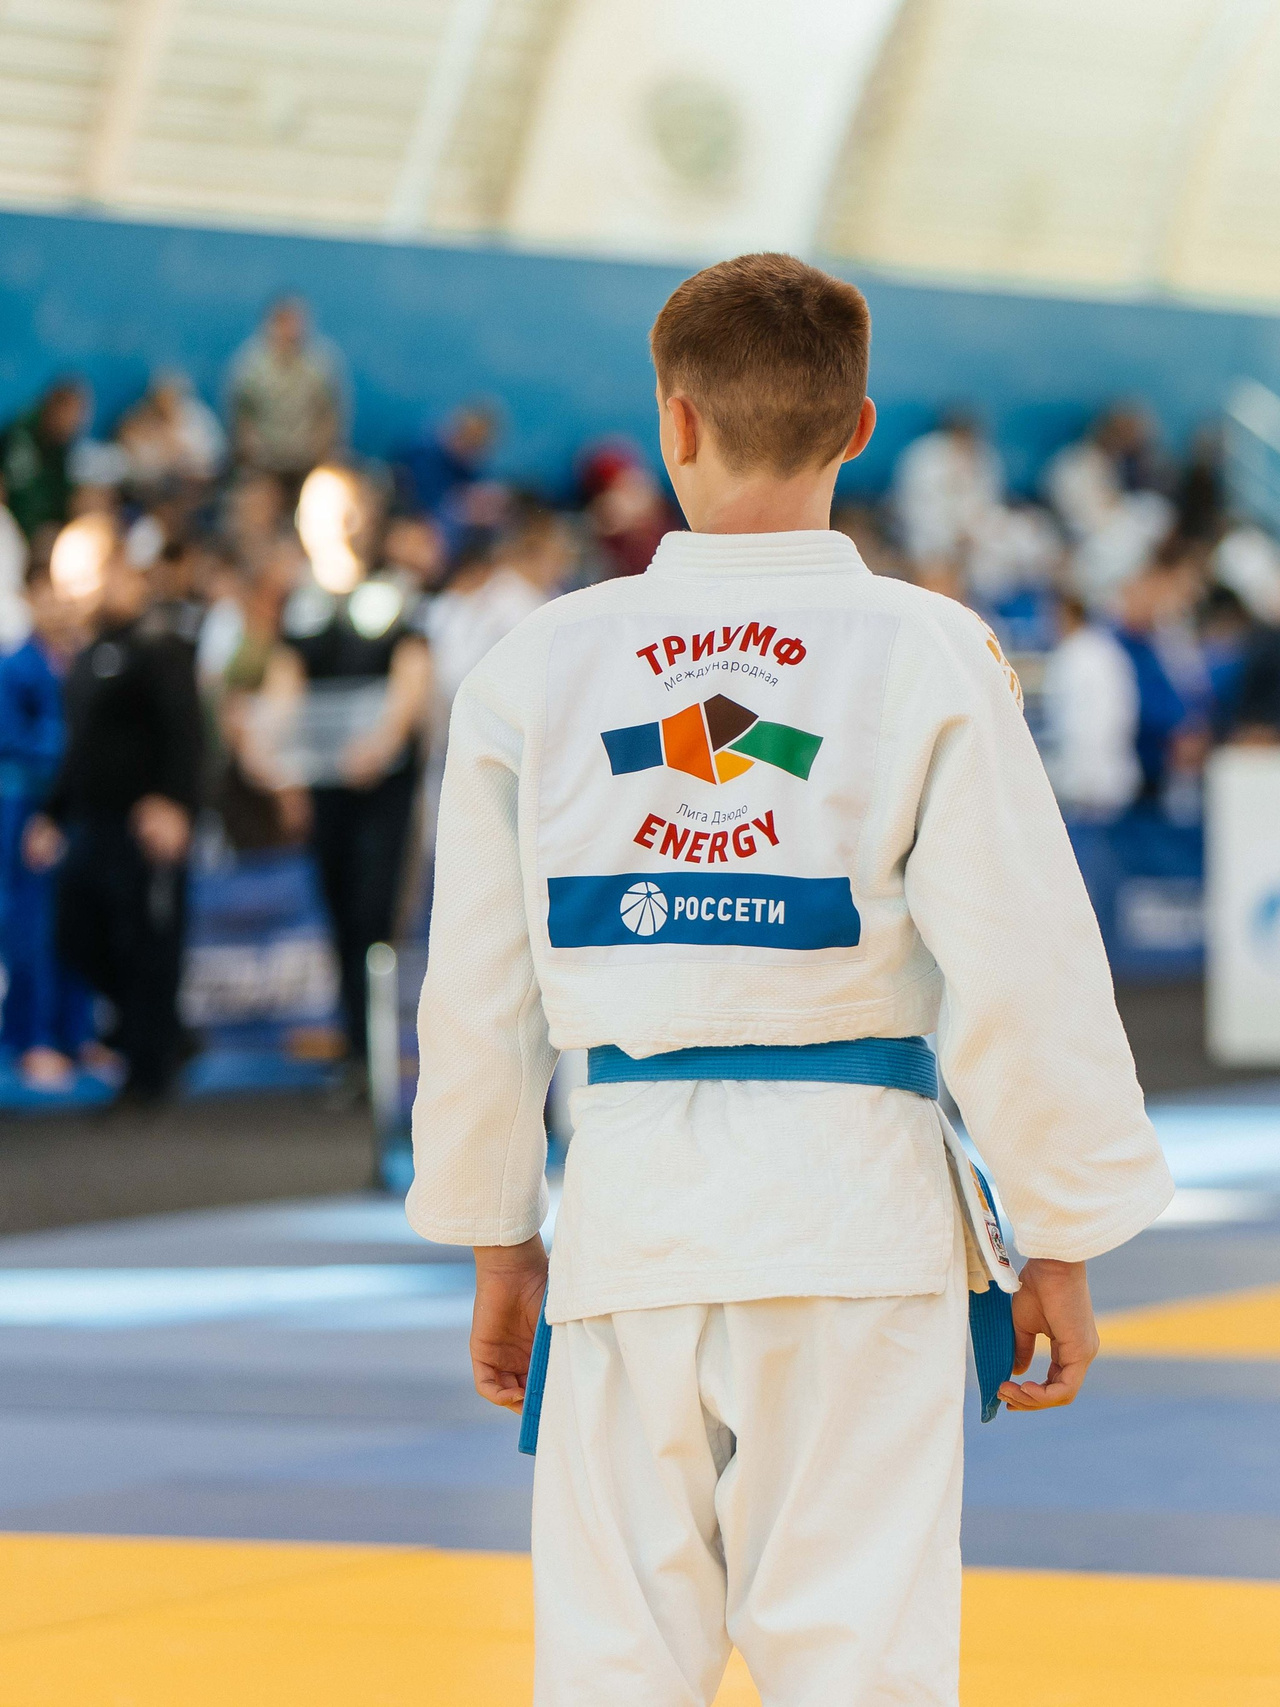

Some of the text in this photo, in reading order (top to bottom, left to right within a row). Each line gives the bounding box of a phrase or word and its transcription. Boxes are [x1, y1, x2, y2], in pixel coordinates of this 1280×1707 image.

[636, 622, 807, 676] ТРИУМФ
[663, 659, 779, 692] Международная
[676, 803, 749, 825] Лига Дзюдо
[633, 811, 780, 864] ENERGY
[673, 896, 786, 925] РОССЕТИ
